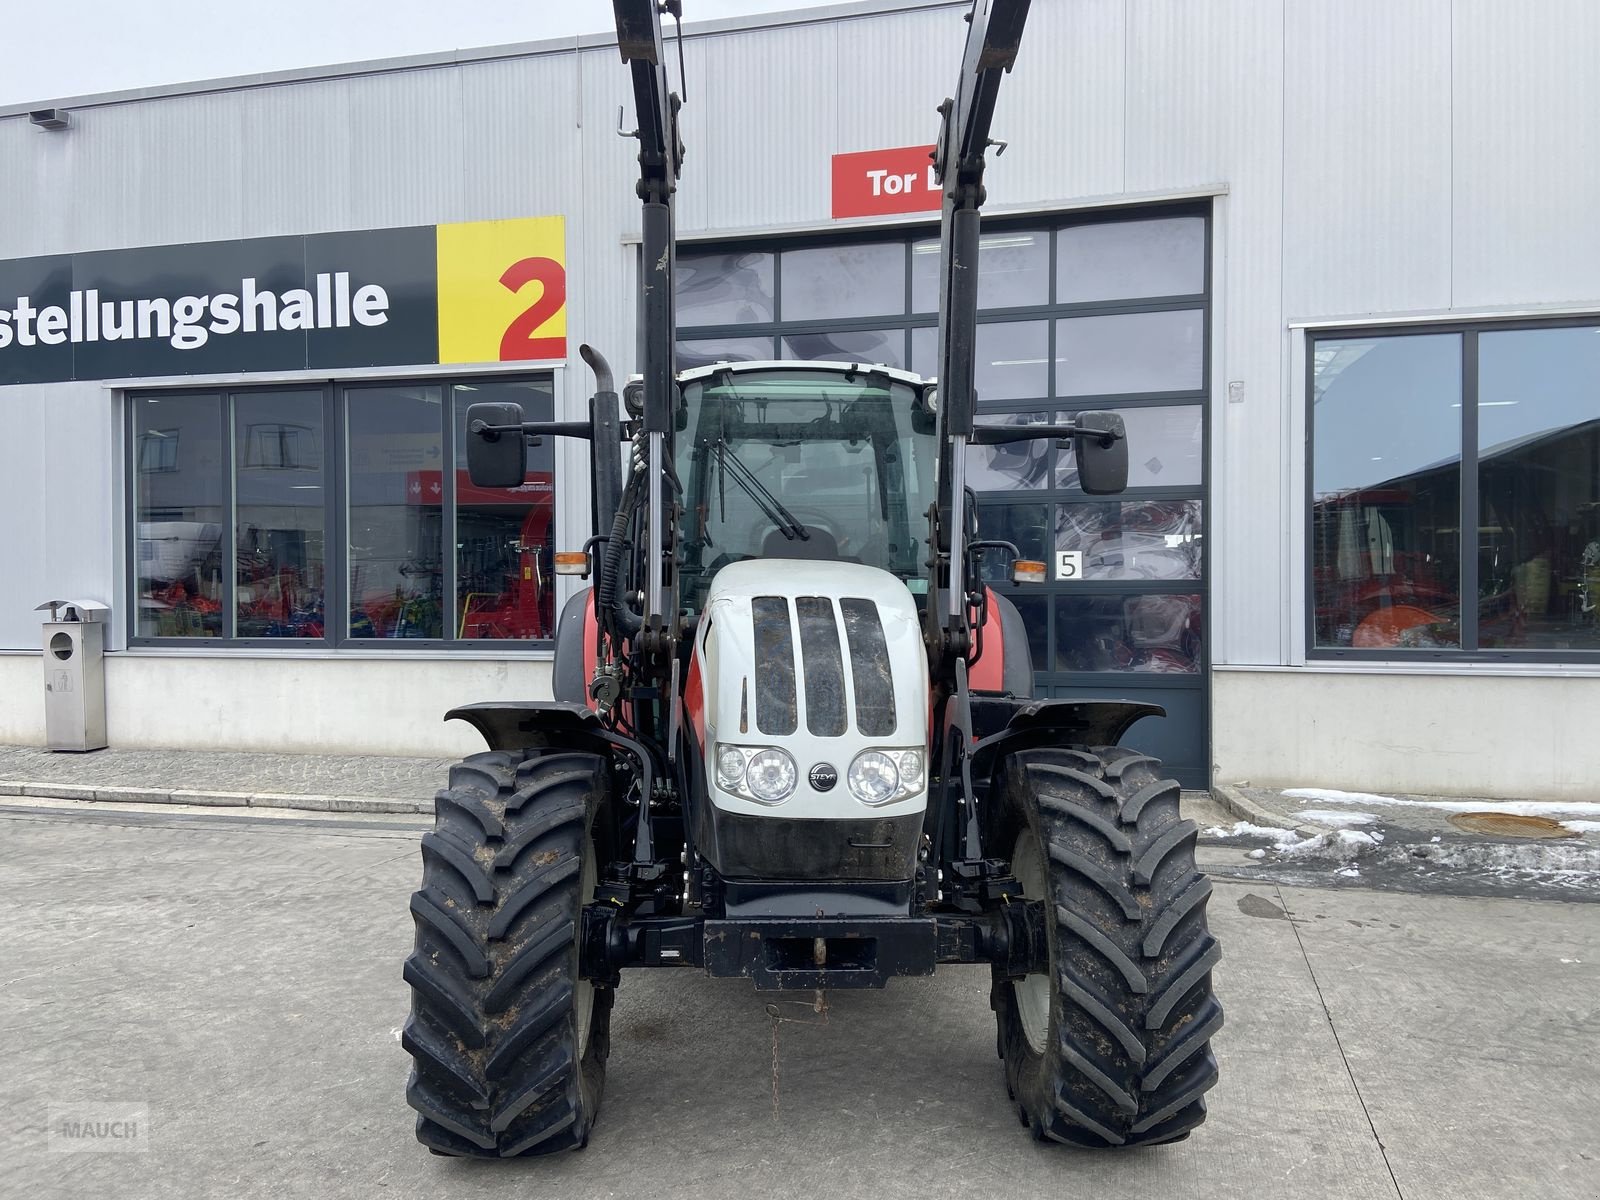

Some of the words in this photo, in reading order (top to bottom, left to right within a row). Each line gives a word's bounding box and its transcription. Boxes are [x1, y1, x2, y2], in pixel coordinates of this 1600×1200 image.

[866, 169, 917, 196] Tor
[498, 256, 567, 361] 2
[1061, 554, 1076, 577] 5
